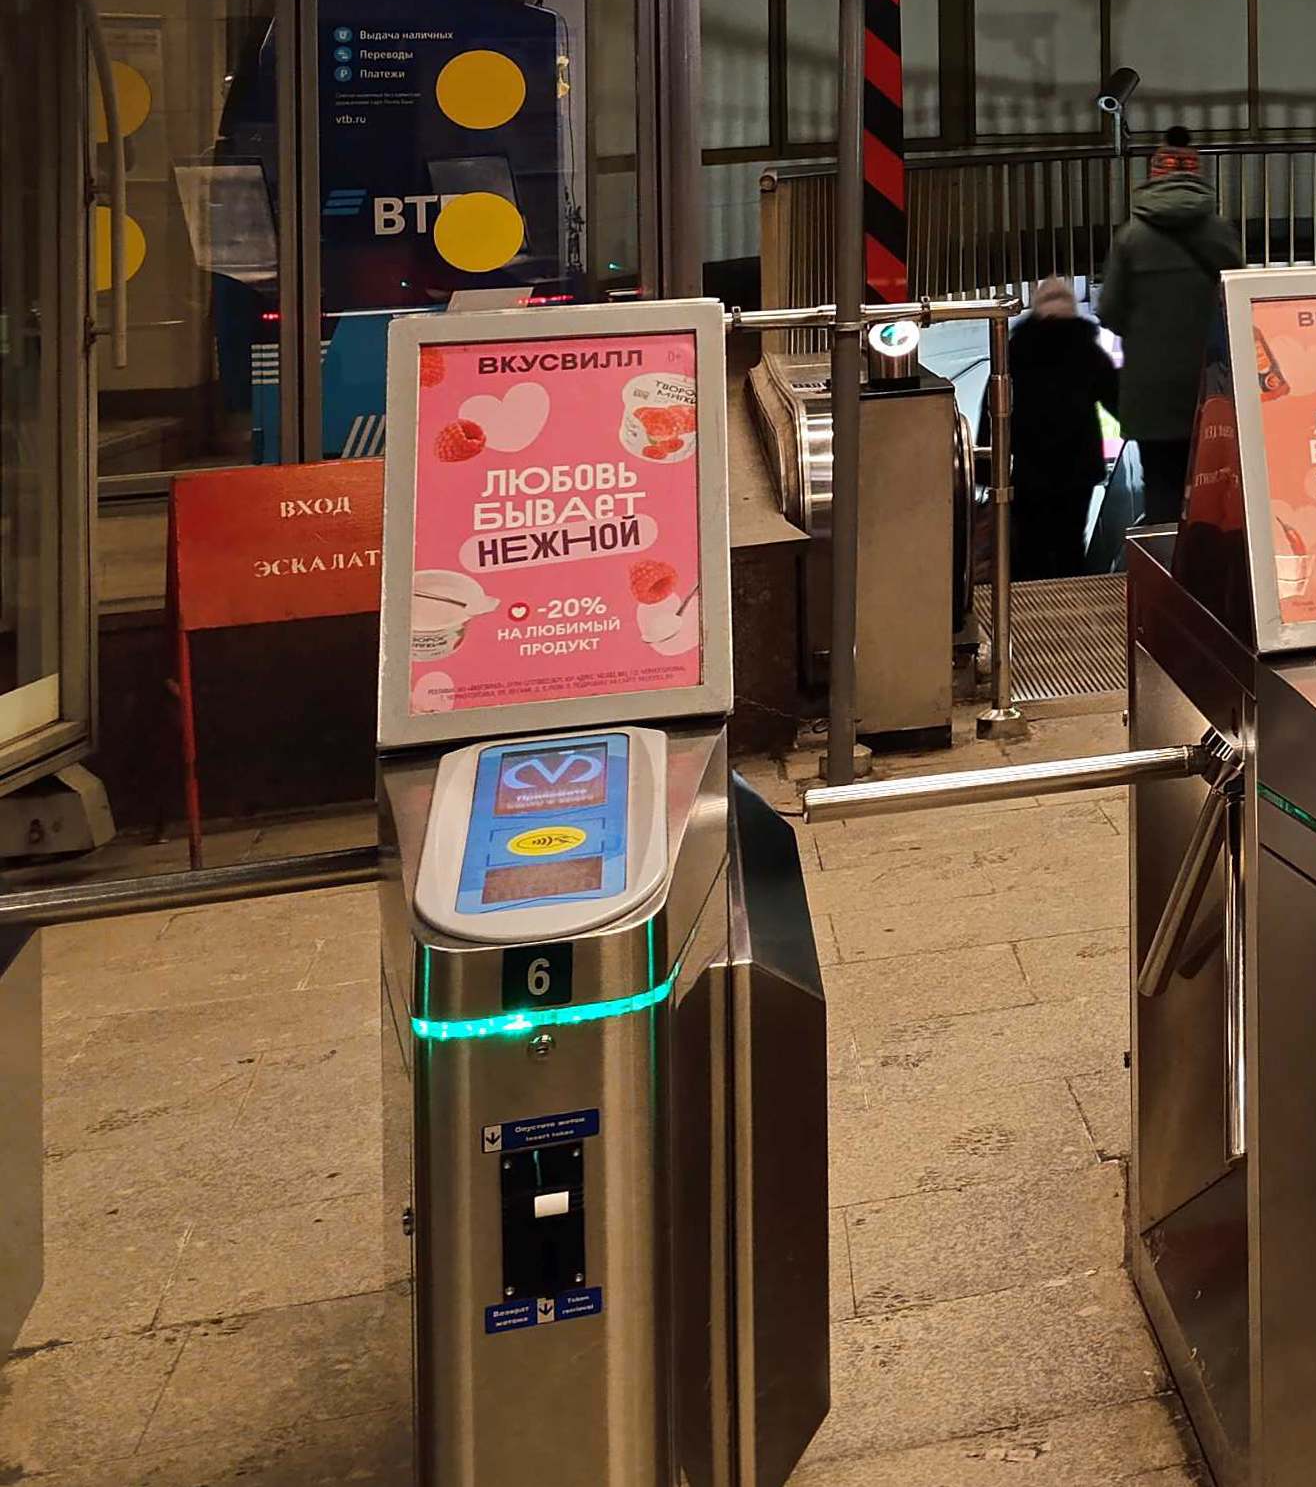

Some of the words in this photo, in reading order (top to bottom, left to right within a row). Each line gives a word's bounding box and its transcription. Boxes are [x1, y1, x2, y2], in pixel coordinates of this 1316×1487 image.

[360, 30, 400, 41] Выдача
[402, 31, 454, 40] наличных
[360, 50, 413, 60] Переводы
[360, 69, 405, 79] Платежи
[336, 114, 366, 125] vtb.ru
[374, 193, 464, 236] ВТ
[478, 349, 643, 375] ВКУСВИЛЛ
[656, 380, 696, 397] ТВОРО
[481, 462, 638, 498] ЛЮБОВЬ
[279, 496, 352, 518] ВХОД
[477, 514, 641, 568] НЕЖНОЙ
[537, 596, 607, 619] -20%
[497, 626, 522, 642] НА
[525, 615, 621, 638] ЛЮБИМЫЙ
[519, 636, 600, 657] ПРОДУКТ
[527, 957, 551, 996] 6
